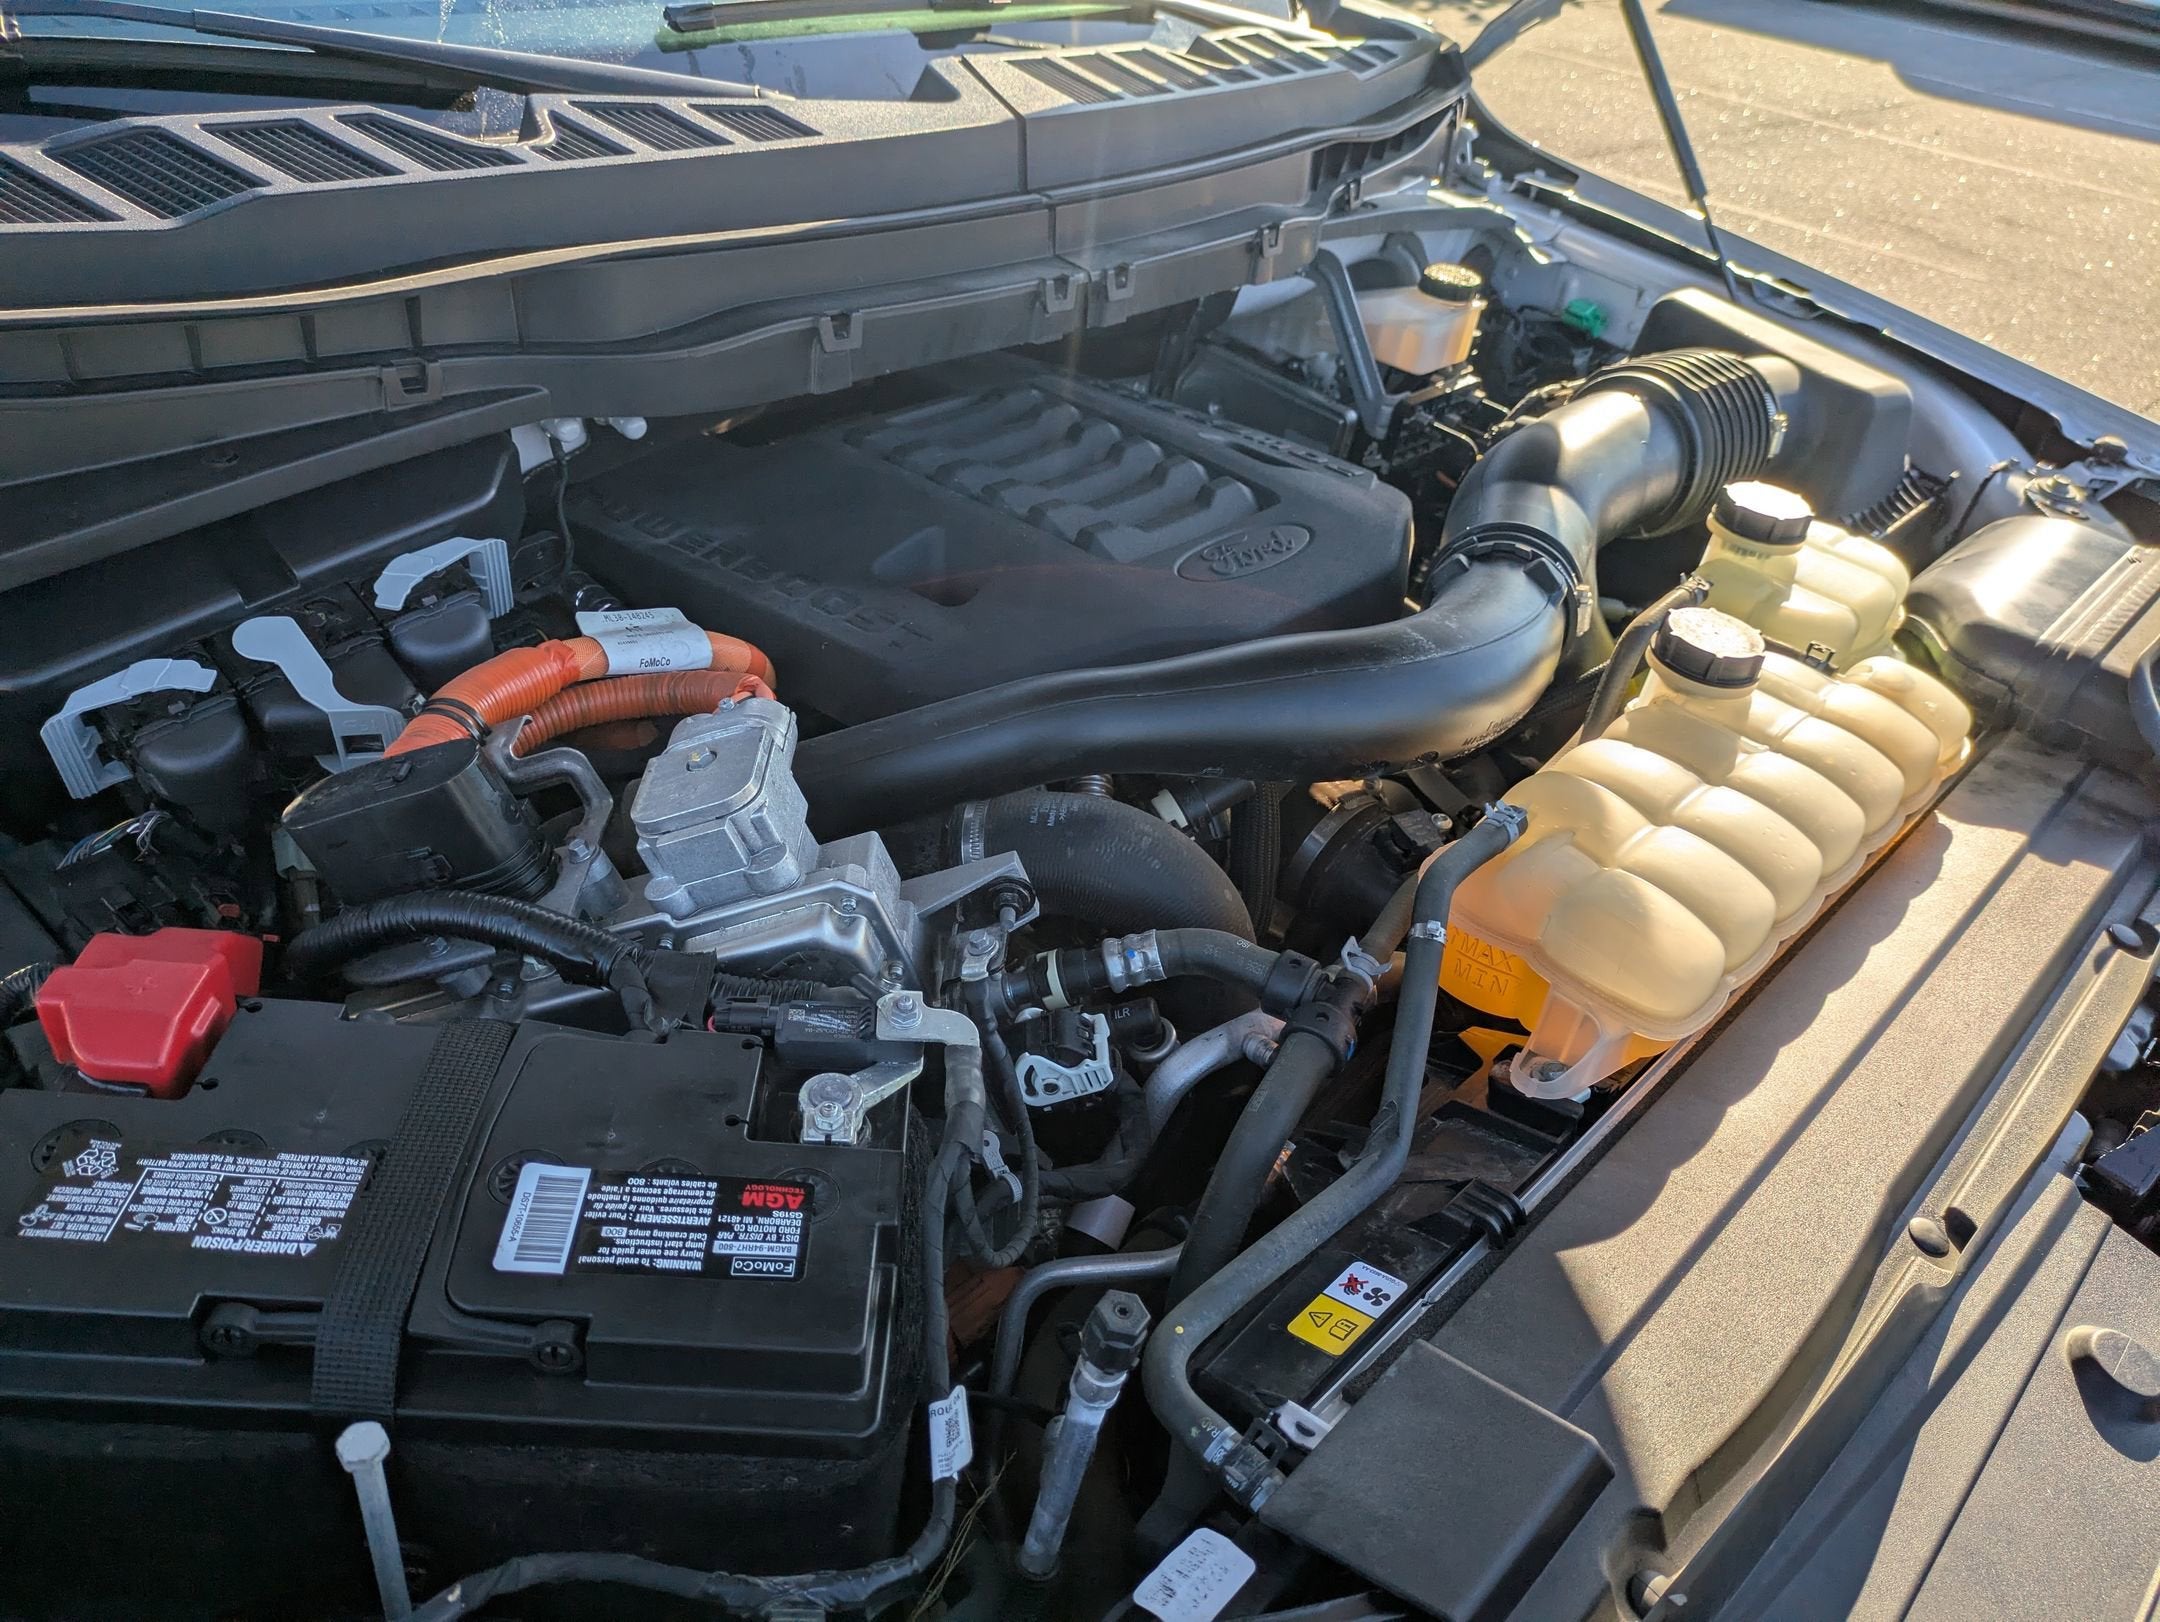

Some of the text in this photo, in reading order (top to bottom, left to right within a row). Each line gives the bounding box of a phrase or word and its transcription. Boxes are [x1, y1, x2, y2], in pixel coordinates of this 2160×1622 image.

[1201, 530, 1295, 576] Ford
[639, 656, 671, 669] FoMoCo
[1461, 932, 1517, 972] MAX
[1454, 958, 1509, 996] MIN
[344, 1165, 365, 1174] TENIR
[333, 1172, 346, 1180] OUT
[652, 1179, 680, 1187] volants
[681, 1180, 706, 1188] cables
[600, 1185, 623, 1194] l'aide
[663, 1188, 704, 1197] demarrage
[745, 1184, 805, 1194] TECHNOLOGY
[166, 1198, 192, 1207] SEVERE
[587, 1193, 715, 1206] proprietaire quidonne la methode
[741, 1191, 804, 1210] AGM
[164, 1205, 185, 1214] CAUSE
[605, 1202, 628, 1210] guide
[639, 1205, 655, 1213] Voir
[657, 1206, 697, 1214] blessures.
[698, 1207, 713, 1215] des
[175, 1215, 195, 1224] ACID
[299, 1216, 321, 1225] GASES
[584, 1211, 711, 1226] AVERTISSEMENT Pour eviter
[717, 1214, 801, 1226] DEARBORN, MI 48121
[153, 1222, 191, 1232] SULFURIC
[271, 1223, 310, 1232] EXPLOSIVE
[747, 1224, 777, 1233] MOTOR
[779, 1226, 800, 1234] FORD
[236, 1228, 248, 1237] NO
[261, 1231, 306, 1240] SHIELD EYES
[628, 1228, 651, 1237] amps
[652, 1229, 687, 1239] cranking
[689, 1232, 707, 1240] Cold
[716, 1231, 799, 1243] DIST. BY DISTR. PAR
[191, 1235, 298, 1254] DANGER/POISON
[613, 1238, 663, 1247] instructions.
[685, 1240, 706, 1250] jump
[718, 1243, 792, 1253] BAGM-94RH7-800
[680, 1249, 704, 1259] injury
[578, 1255, 702, 1271] WARNING: To avoid personal
[734, 1260, 793, 1273] FoMoCo
